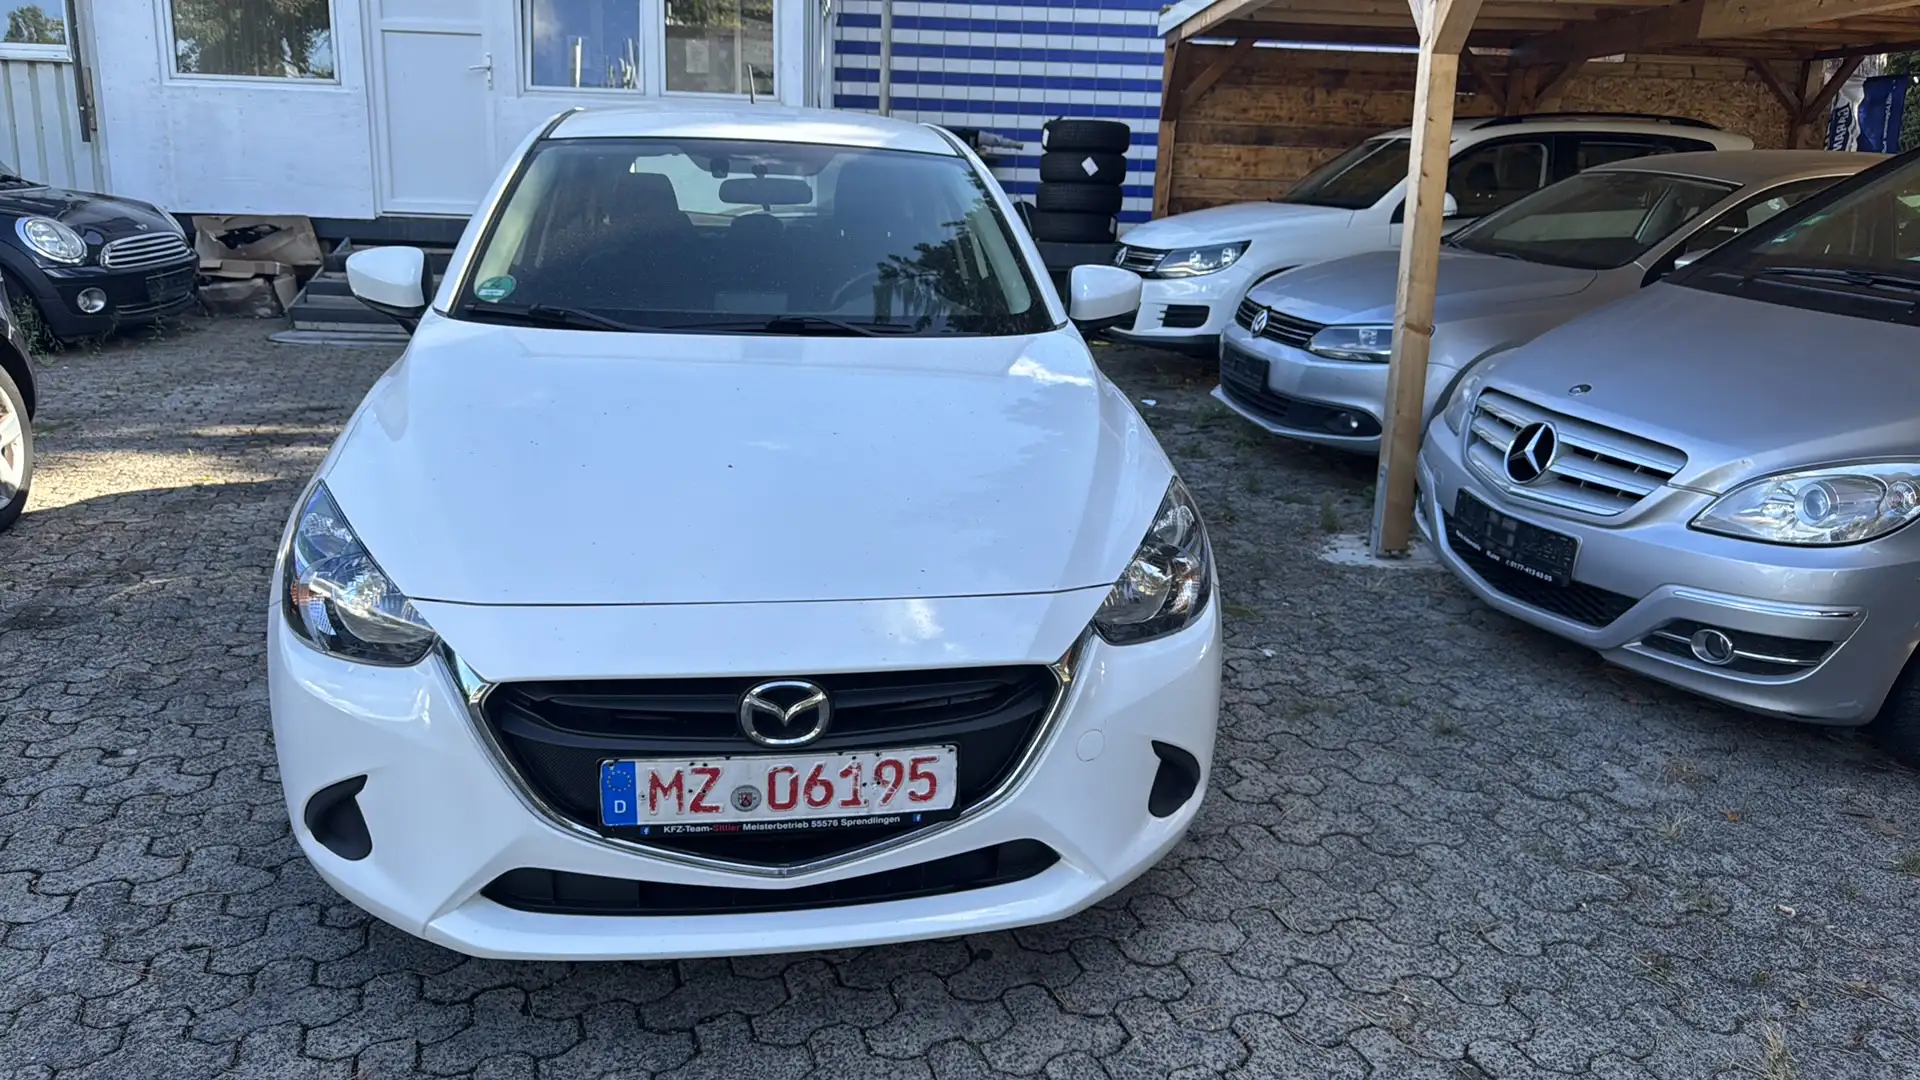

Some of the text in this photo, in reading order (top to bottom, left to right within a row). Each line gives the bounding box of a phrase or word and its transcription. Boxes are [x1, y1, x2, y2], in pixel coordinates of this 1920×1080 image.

[649, 756, 939, 814] MZ 06195
[614, 800, 626, 813] D
[743, 821, 808, 831] Meisterbetrieb
[811, 819, 839, 829] 55576
[840, 815, 901, 827] Sprendlingen
